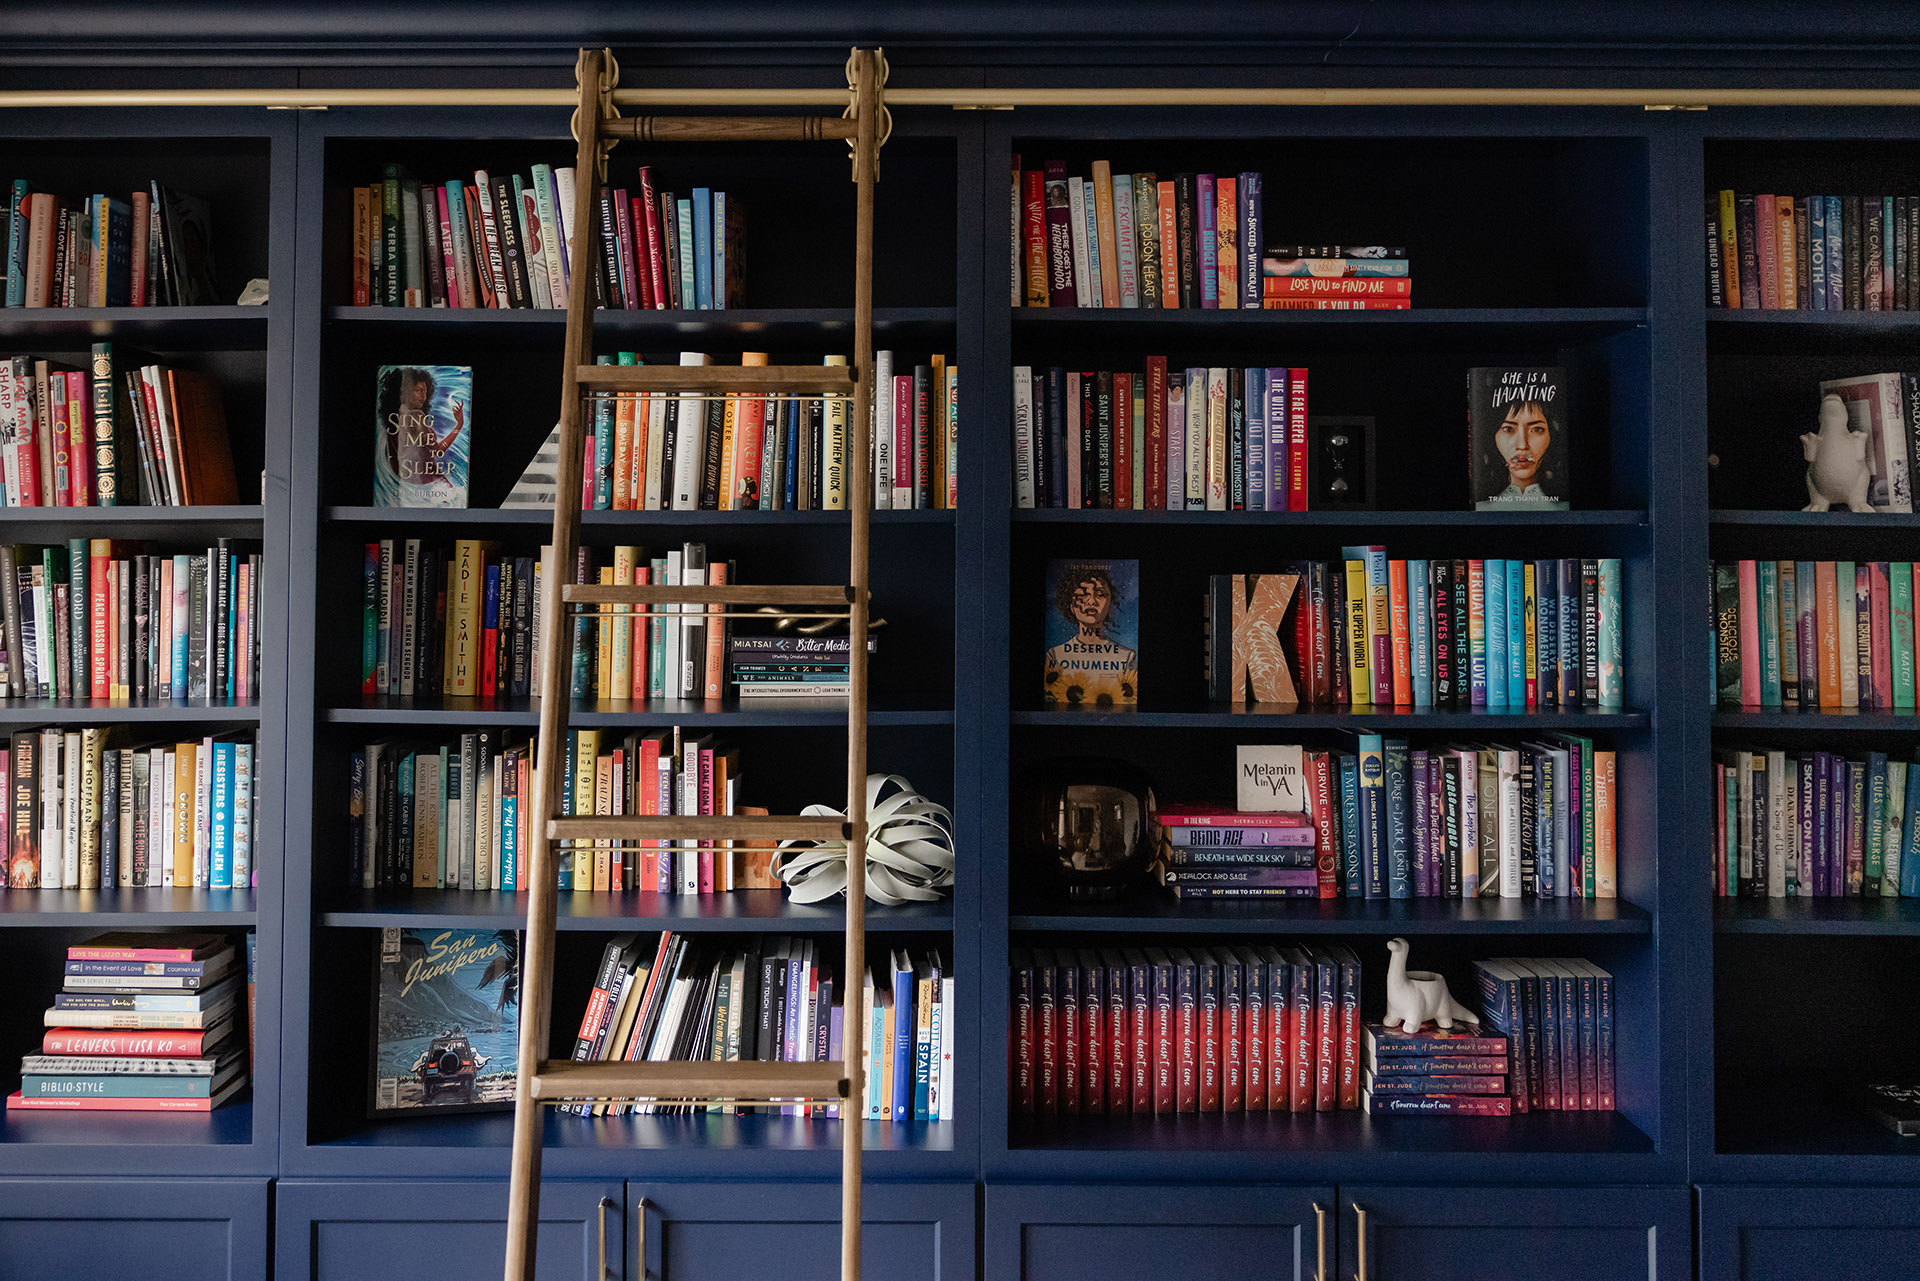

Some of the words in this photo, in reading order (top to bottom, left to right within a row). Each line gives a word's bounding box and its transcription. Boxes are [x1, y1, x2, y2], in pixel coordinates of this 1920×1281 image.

[1165, 208, 1173, 227] FAR
[1708, 222, 1716, 236] THE
[388, 226, 396, 260] YERBA
[648, 225, 657, 245] Toni
[1061, 223, 1069, 249] THERE
[1247, 217, 1257, 248] SUCCEED
[1051, 223, 1064, 290] NEIGHBORHOOD
[1203, 230, 1216, 267] BRIDGET
[1709, 238, 1718, 267] UNDEAD
[1812, 239, 1824, 283] MOTH
[650, 247, 659, 286] Morrison
[1247, 253, 1258, 298] WITCHCRAFT
[388, 265, 396, 302] BUENA
[1204, 269, 1216, 300] BLOOM
[1290, 278, 1309, 290] LOSE
[1310, 280, 1330, 294] YOU
[1341, 280, 1367, 293] FIND
[1368, 281, 1384, 293] ME
[1711, 270, 1720, 294] TRUTH
[1712, 295, 1721, 305] OF
[0, 366, 10, 409] SHARP
[1271, 379, 1284, 393] THE
[1292, 379, 1304, 394] THE
[1502, 372, 1523, 385] SHE
[1527, 372, 1538, 383] IS
[1540, 372, 1547, 383] A
[918, 392, 928, 413] KEEP
[1099, 395, 1108, 421] SAINT
[1271, 396, 1284, 421] WITCH
[1292, 396, 1304, 412] FAE
[1492, 385, 1557, 408] HAUNTING
[387, 412, 436, 436] SING
[919, 414, 927, 432] THIS
[1249, 419, 1263, 438] HOT
[1271, 424, 1284, 444] KING
[1292, 414, 1304, 444] KEEPER
[404, 432, 436, 448] ME
[832, 424, 842, 465] MATTHEW
[919, 434, 926, 445] TO
[1099, 423, 1109, 466] JUNIPER'S
[430, 450, 445, 458] TO
[880, 443, 888, 464] ONE
[1249, 444, 1262, 465] DOG
[401, 459, 456, 480] SLEEP
[830, 466, 840, 492] QUICK
[880, 467, 888, 488] LIFE
[918, 447, 927, 488] YOURSELF
[1100, 468, 1109, 493] FOLLY
[1249, 470, 1263, 494] GIRL
[72, 549, 83, 584] JAMIE
[1373, 554, 1383, 583] Pedro
[73, 587, 84, 620] FORD
[1375, 586, 1384, 595] &
[1436, 590, 1446, 608] ALL
[1455, 584, 1465, 605] SEE
[1472, 572, 1484, 616] FRIDAY
[95, 593, 104, 617] PEACH
[1352, 598, 1364, 613] THE
[1375, 599, 1386, 631] Daniel
[1456, 607, 1465, 629] ALL
[95, 620, 104, 654] BLOSSOM
[1082, 627, 1102, 638] WE
[1353, 615, 1364, 639] UPPER
[1437, 612, 1447, 640] EYES
[1472, 620, 1485, 637] I'M
[1586, 606, 1595, 653] RECKLESS
[1719, 612, 1728, 665] MONSTERS
[1728, 607, 1737, 662] DELICIOUS
[734, 640, 751, 648] MIA
[1064, 643, 1120, 654] DESERVE
[1354, 640, 1365, 668] WORLD
[1438, 644, 1447, 659] ON
[1457, 631, 1466, 654] THE
[1473, 640, 1485, 653] IN
[95, 657, 105, 685] SPRING
[1049, 660, 1136, 671] MONUMENTS
[1438, 664, 1448, 678] US
[1457, 657, 1467, 693] STARS
[1473, 657, 1485, 687] LOVE
[1586, 655, 1596, 678] KIND
[17, 745, 32, 778] FIREMAN
[86, 735, 94, 764] ALICE
[120, 753, 132, 814] BOTTOMLAND
[215, 754, 225, 808] RESISTERS
[1243, 764, 1296, 787] Melanin
[1260, 779, 1268, 787] in
[1267, 776, 1293, 796] YA
[1317, 762, 1328, 805] SURVIVE
[1584, 768, 1592, 808] NOTABLE
[16, 785, 31, 807] JOE
[85, 770, 93, 823] HOFFMAN
[1343, 771, 1356, 820] EMPRESS
[1466, 793, 1476, 809] The
[1483, 785, 1496, 819] ONE
[1804, 764, 1812, 818] SKATING
[1873, 775, 1884, 804] CLUES
[16, 810, 31, 836] HILL
[1320, 821, 1330, 851] DOME
[1463, 811, 1476, 848] Loophole
[1584, 811, 1592, 843] NATIVE
[1803, 820, 1812, 840] ON
[215, 825, 225, 849] GISH
[1871, 819, 1882, 865] UNIVERSE
[214, 851, 224, 871] JEN
[1346, 830, 1358, 879] SEASONS
[1483, 835, 1496, 867] ALL
[1803, 842, 1812, 877] MARS
[426, 931, 477, 963] San
[400, 942, 500, 998] Junipero
[616, 967, 627, 983] WINE
[610, 983, 622, 1002] FOLLY
[1135, 993, 1145, 1002] if
[1272, 992, 1283, 1001] if
[1343, 991, 1354, 1000] if
[1136, 1003, 1147, 1036] tomorrow
[1274, 1001, 1284, 1035] tomorrow
[1345, 1001, 1356, 1034] tomorrow
[50, 1041, 63, 1050] THE
[66, 1039, 116, 1053] LEAVERS
[128, 1040, 153, 1053] LISA
[158, 1040, 173, 1053] KO
[930, 1008, 940, 1072] SCOTLAND
[1137, 1038, 1147, 1066] doesn't
[1274, 1037, 1285, 1065] doesn't
[1345, 1036, 1356, 1064] doesn't
[918, 1044, 929, 1084] SPAIN
[1274, 1067, 1283, 1086] come
[1345, 1066, 1354, 1085] come
[41, 1081, 104, 1093] BIBLIO-STYLE
[1137, 1068, 1146, 1088] come
